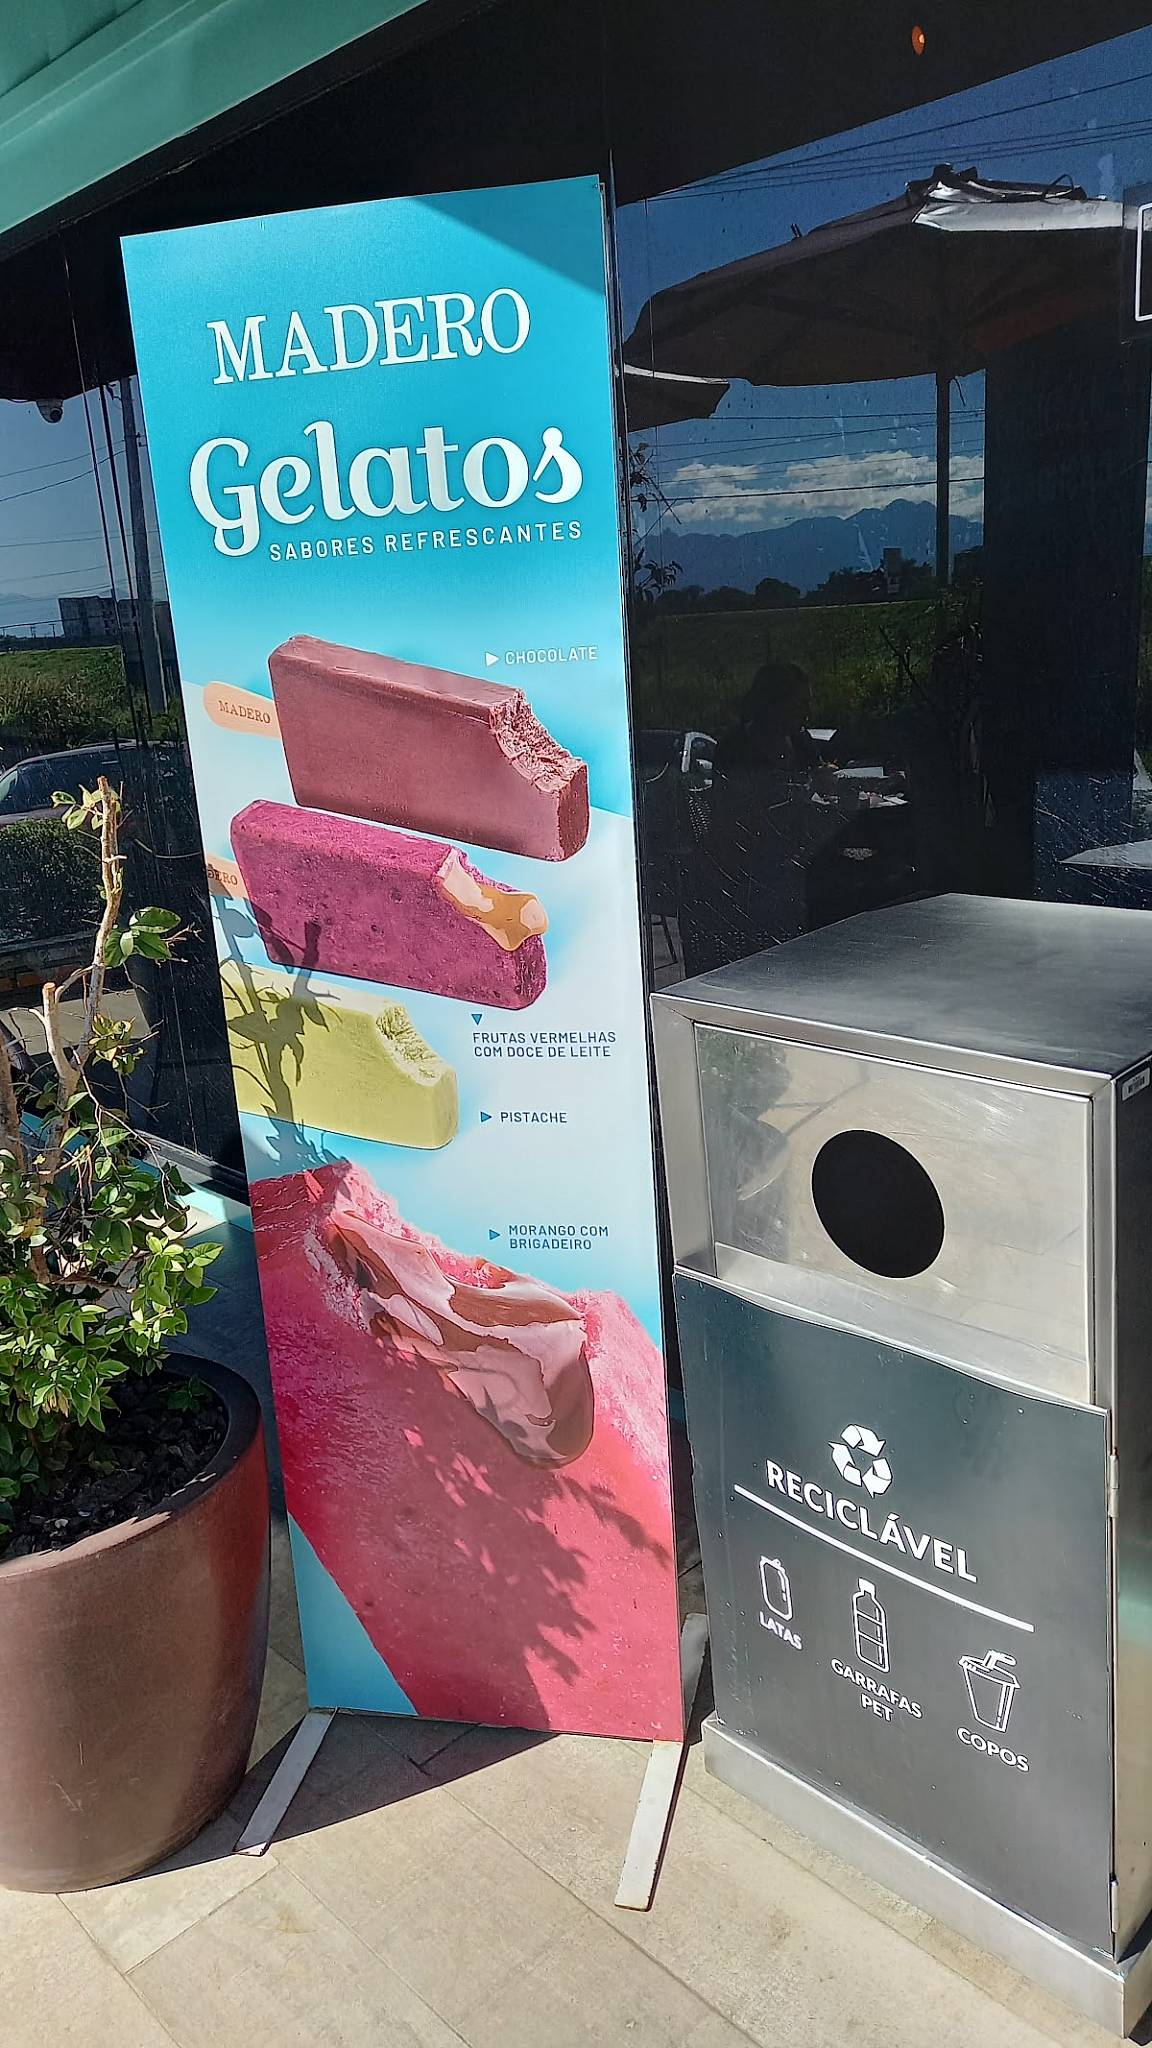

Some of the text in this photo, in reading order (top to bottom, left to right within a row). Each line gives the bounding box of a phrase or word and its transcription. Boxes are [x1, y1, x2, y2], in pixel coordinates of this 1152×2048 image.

[207, 288, 531, 384] MADERO
[189, 420, 583, 557] Gelatos
[269, 520, 583, 562] SABORES REFRESCANTES
[505, 646, 599, 666] CHOCOLATE
[218, 700, 271, 724] MADERO
[472, 1031, 617, 1044] FRUTAS VERMELHAS
[474, 1045, 611, 1058] COM DOCE DE LEITE
[500, 1111, 568, 1124] PISTACHE
[508, 1224, 609, 1238] MORANGO COM
[510, 1238, 592, 1250] BRIGADEIRO
[766, 1459, 978, 1583] RECICLÁVEL
[759, 1610, 803, 1651] LATAS
[830, 1658, 923, 1720] GARRAFAS
[861, 1694, 893, 1722] PET
[956, 1727, 1030, 1773] COPOS
